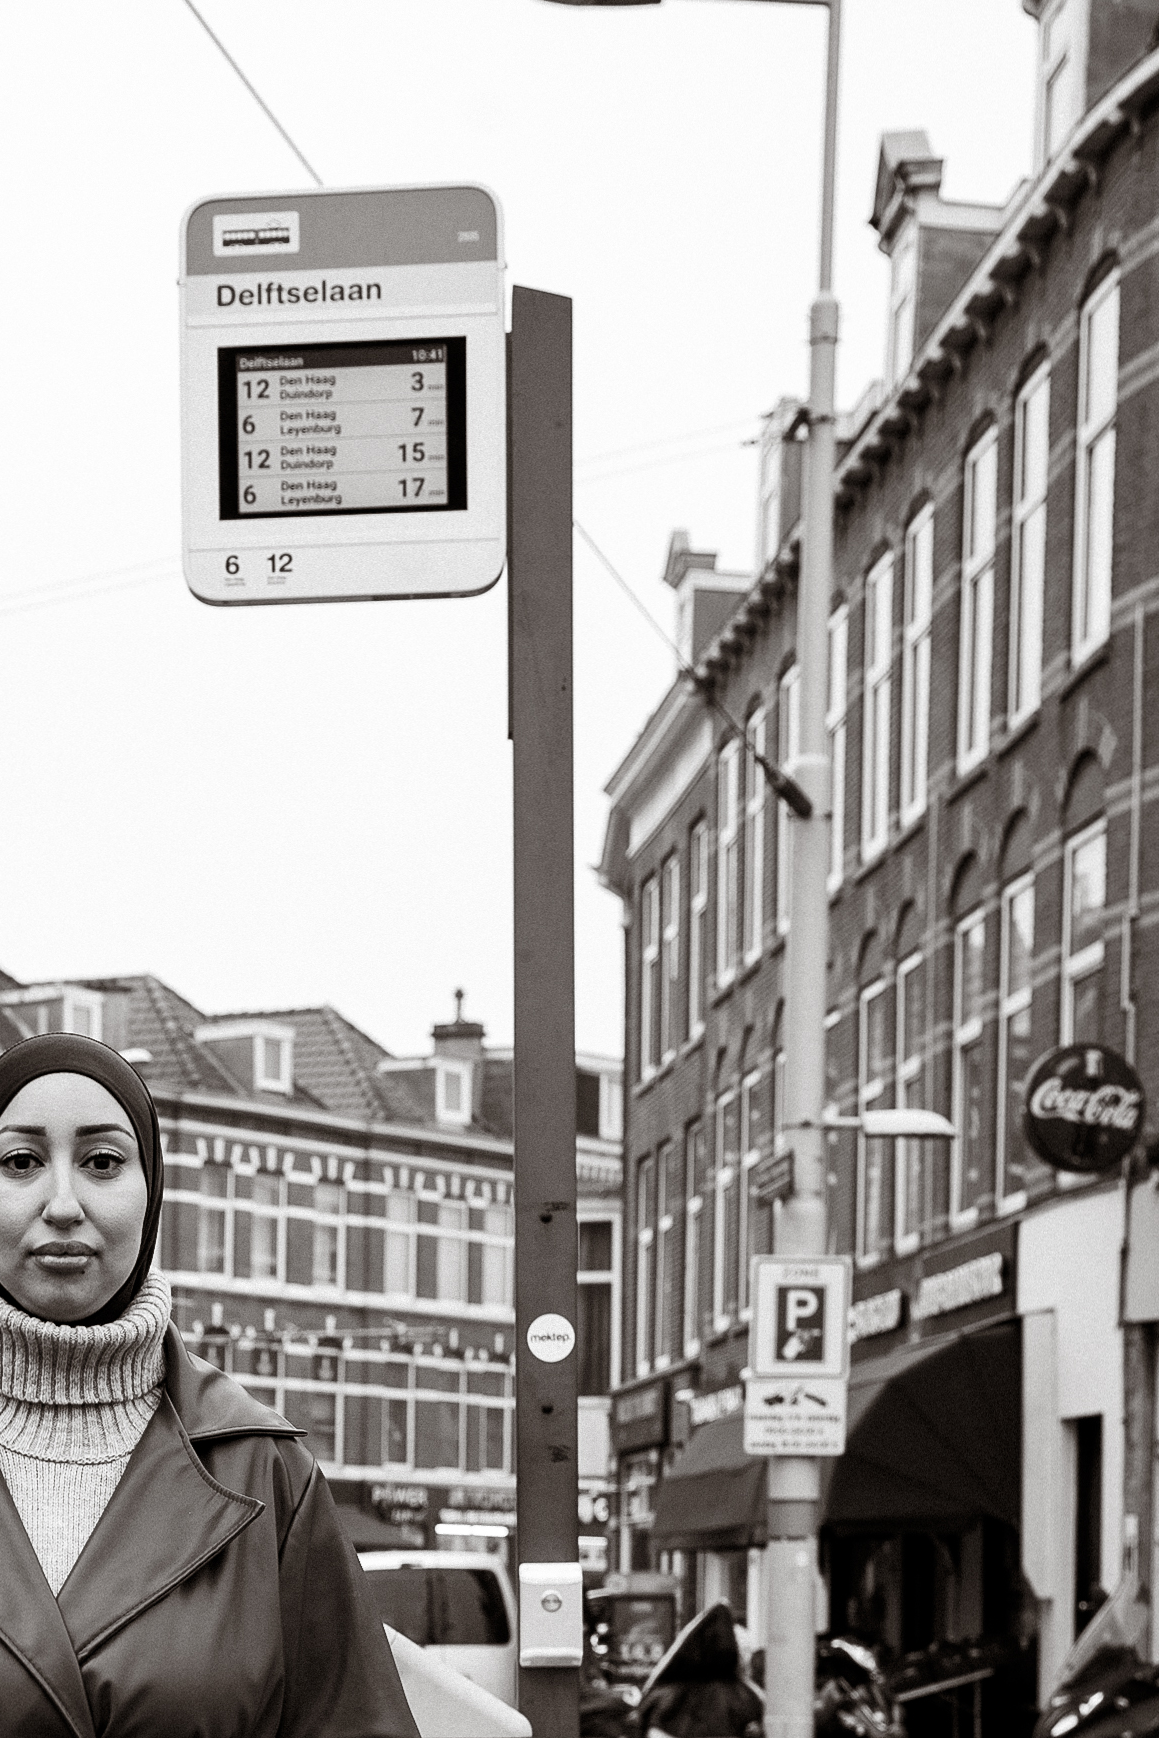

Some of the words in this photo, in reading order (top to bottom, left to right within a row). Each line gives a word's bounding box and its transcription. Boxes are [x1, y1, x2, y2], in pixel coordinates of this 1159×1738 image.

[217, 279, 382, 307] Delftselaan
[239, 356, 304, 370] Delftselaan
[412, 348, 443, 362] 10:41
[243, 378, 270, 400] 12
[279, 375, 302, 387] Den
[305, 373, 337, 387] Haag
[411, 371, 425, 392] 3
[279, 388, 333, 400] Duindorp
[242, 414, 256, 435] 6
[279, 410, 303, 422] Den
[305, 409, 337, 422] Haag
[411, 406, 425, 428] 7
[279, 423, 342, 437] Leyenburg
[244, 449, 271, 470] 12
[280, 445, 303, 457] Den
[305, 444, 337, 457] Haag
[398, 441, 425, 463] 15
[280, 458, 334, 471] Duindorp
[243, 484, 257, 505] 6
[280, 480, 304, 492] Den
[306, 479, 338, 492] Haag
[398, 476, 426, 498] 17
[280, 493, 343, 507] Leyenburg
[225, 554, 240, 575] 6
[267, 552, 293, 573] 12
[785, 1289, 820, 1333] P
